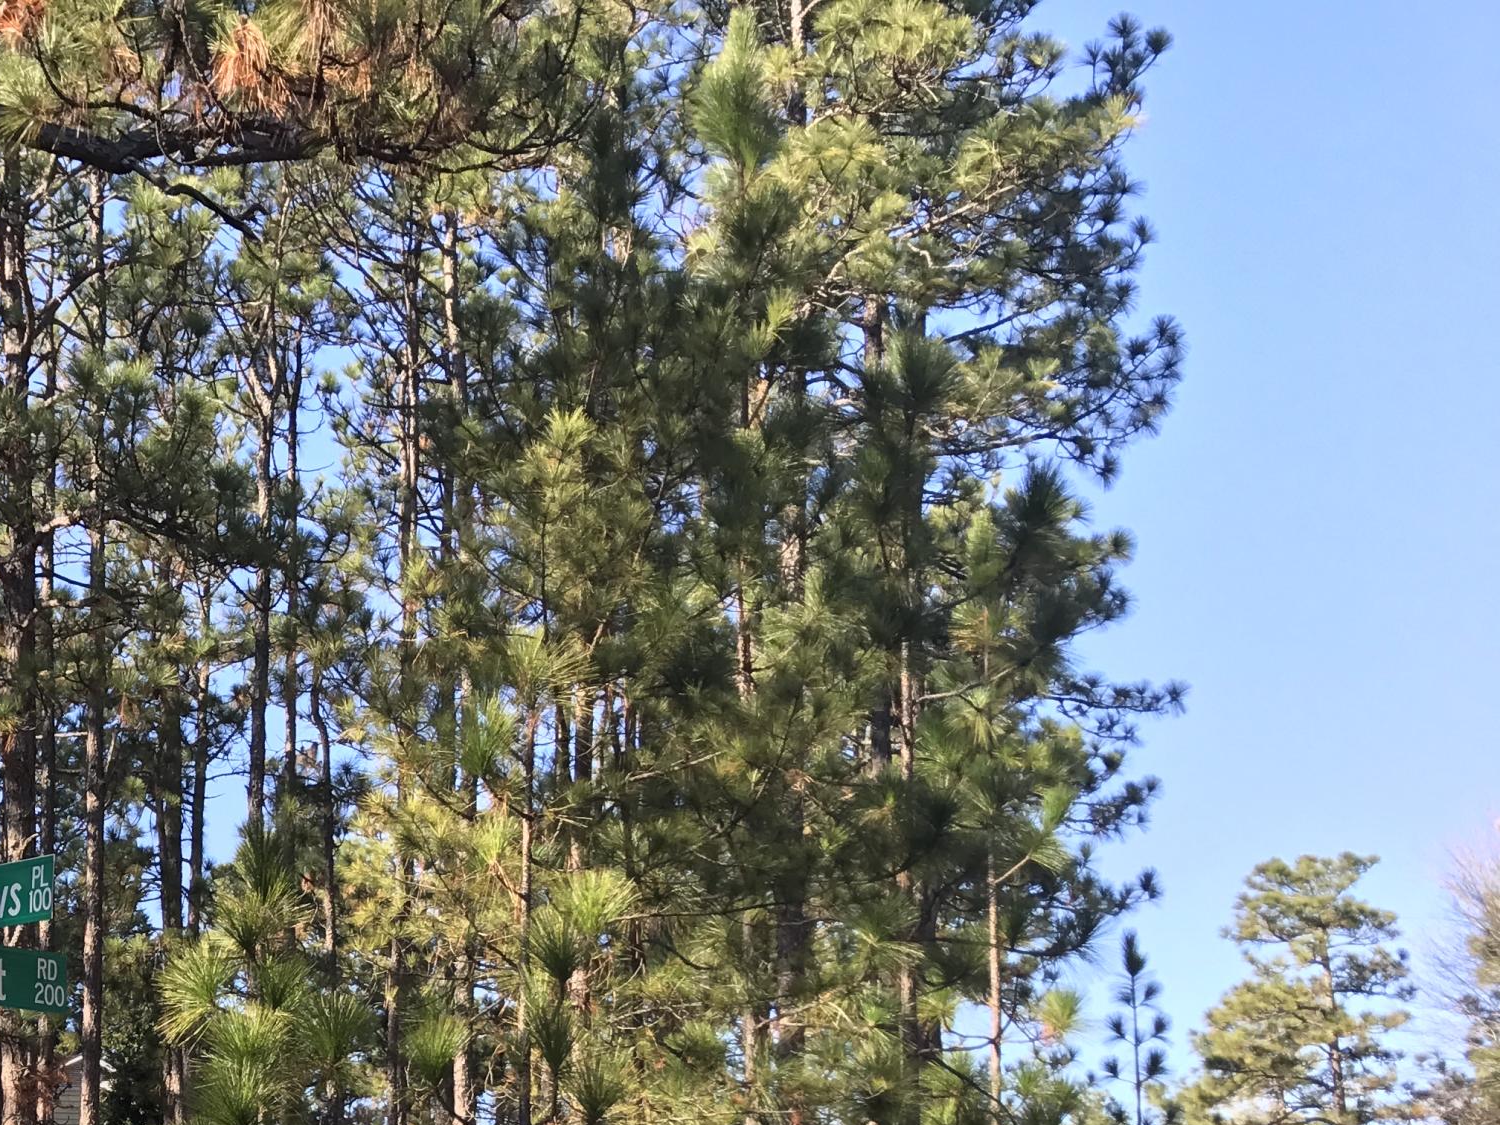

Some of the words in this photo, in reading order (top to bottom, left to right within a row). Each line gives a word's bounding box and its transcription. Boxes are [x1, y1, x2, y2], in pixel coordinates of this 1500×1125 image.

[31, 864, 49, 889] PL
[29, 888, 52, 913] 100
[37, 957, 58, 981] RD
[34, 982, 65, 1007] 200
